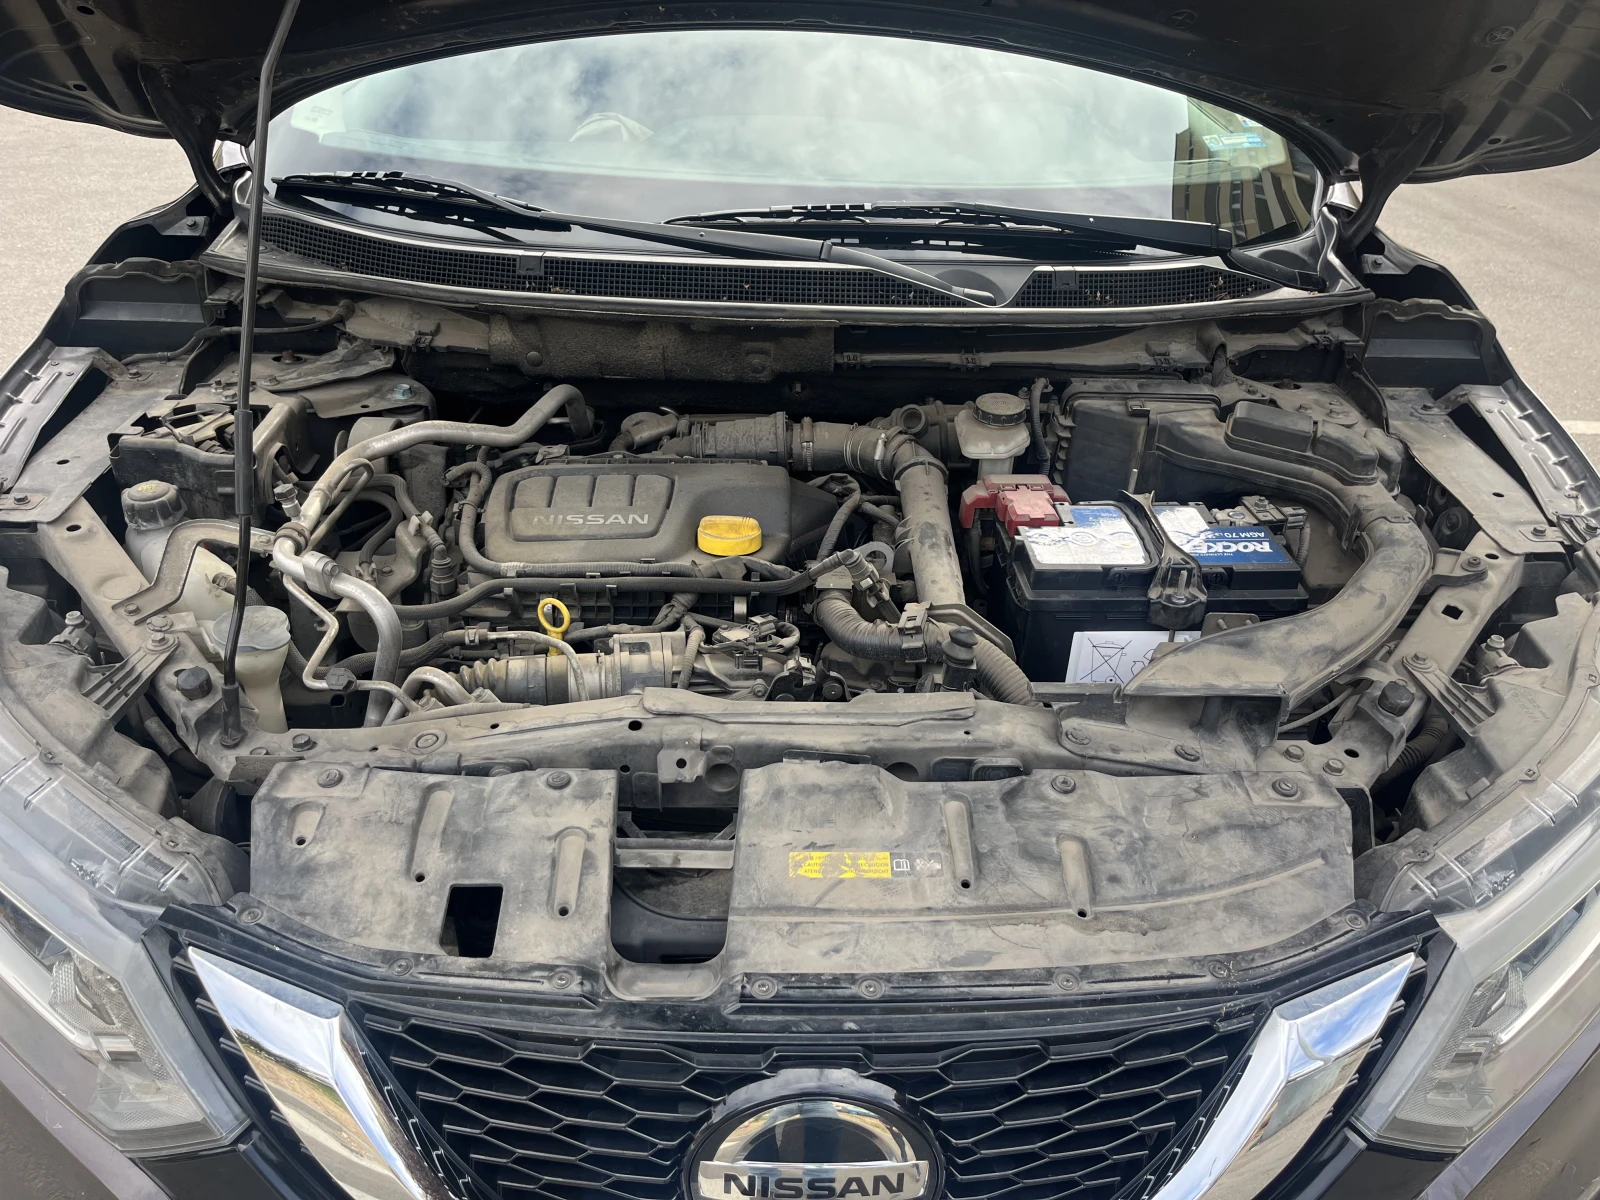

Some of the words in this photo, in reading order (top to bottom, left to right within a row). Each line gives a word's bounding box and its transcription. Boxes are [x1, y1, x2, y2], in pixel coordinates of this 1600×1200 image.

[533, 513, 649, 525] NISSAN
[1185, 541, 1273, 553] ROCKE
[723, 1172, 905, 1199] NISSAN
